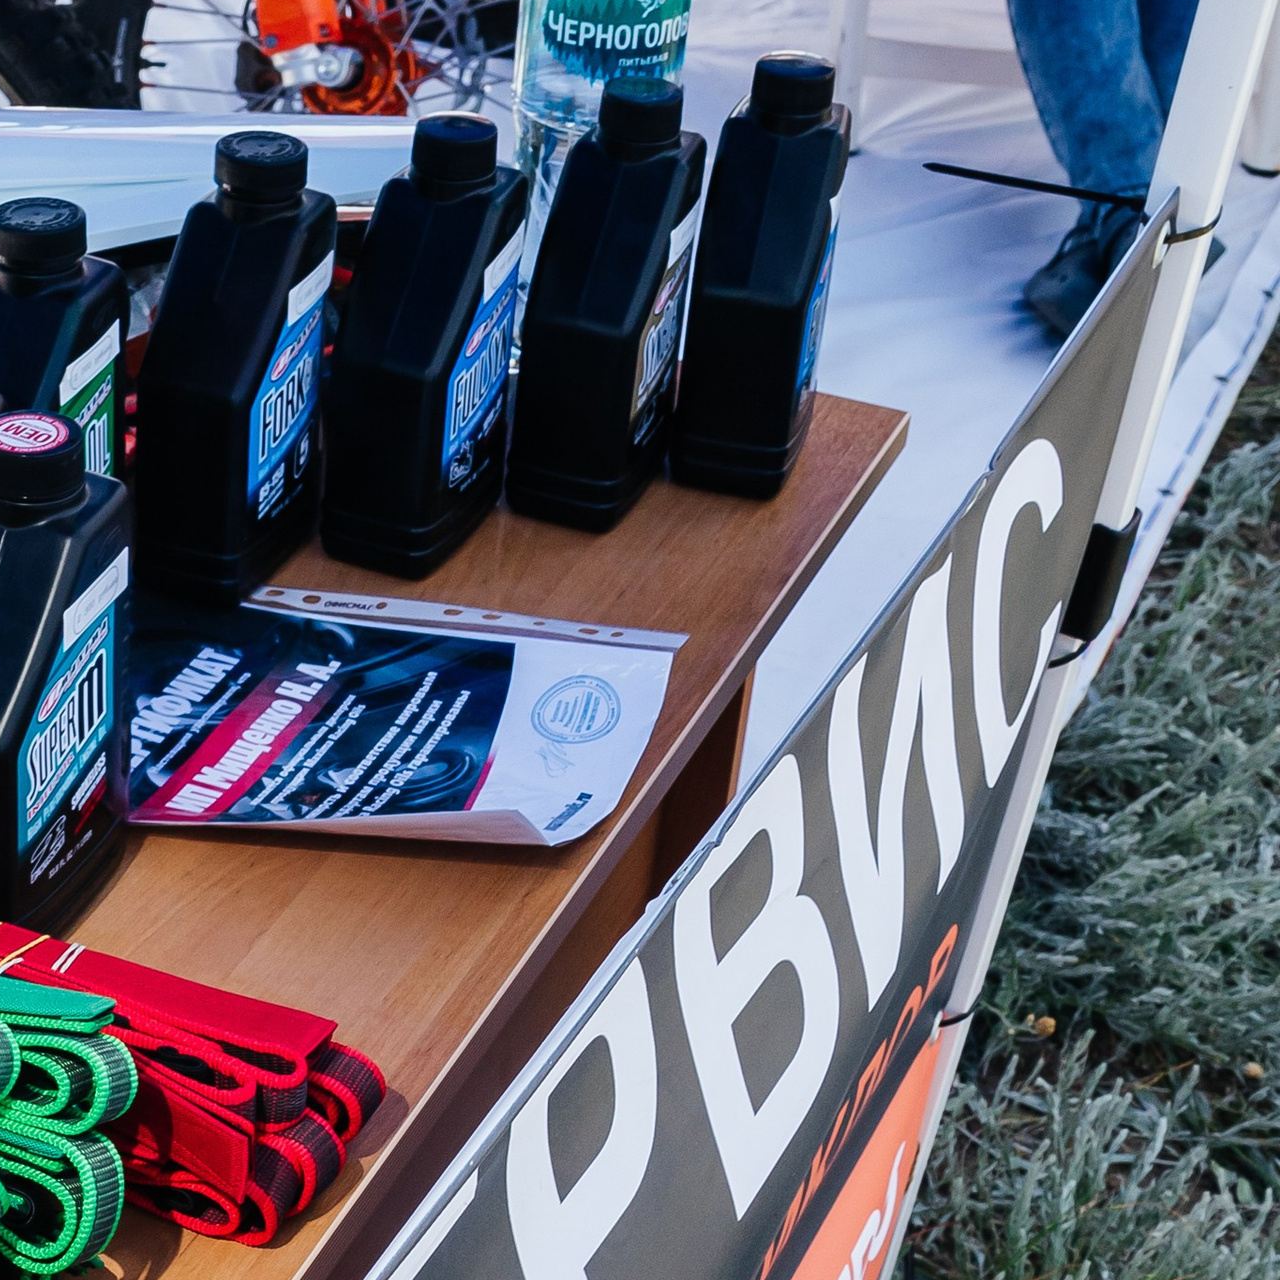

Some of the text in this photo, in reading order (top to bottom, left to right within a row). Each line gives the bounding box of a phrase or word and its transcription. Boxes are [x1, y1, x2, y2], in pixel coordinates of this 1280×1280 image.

[3, 423, 53, 444] OEM
[323, 600, 374, 611] ОФИСМАГ
[130, 647, 241, 773] РТИФИКАТ
[397, 671, 438, 726] мировым
[407, 699, 449, 734] марки
[166, 660, 342, 813] ИП Мищенко Н. А.
